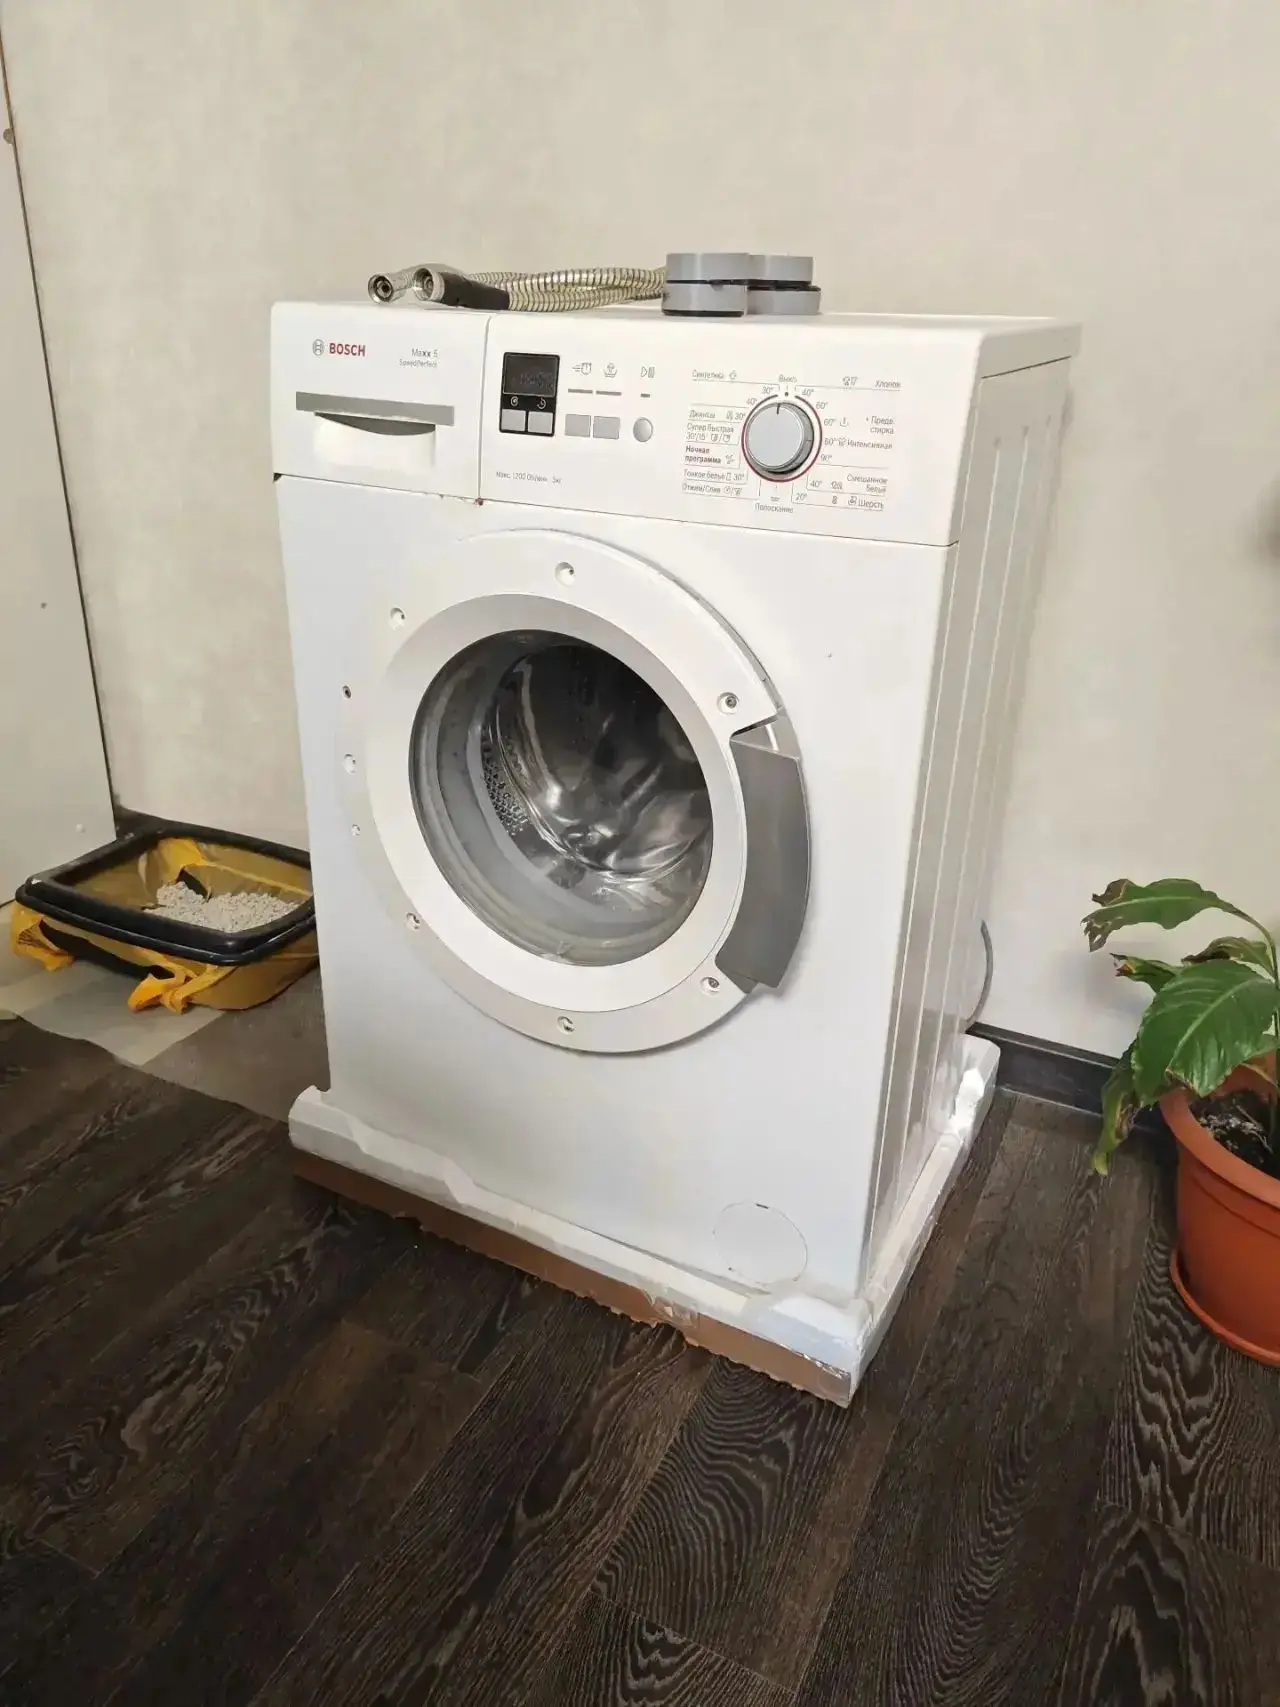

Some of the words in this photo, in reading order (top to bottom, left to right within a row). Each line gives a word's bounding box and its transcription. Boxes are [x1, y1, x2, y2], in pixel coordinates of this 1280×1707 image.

[328, 342, 366, 357] BOSCH
[411, 347, 431, 357] Maxx
[433, 349, 438, 357] 5
[399, 358, 437, 368] SpeedPerfect
[691, 370, 725, 380] Синтетика
[874, 379, 901, 389] Хлопок
[688, 409, 716, 419] Джинсы
[686, 422, 706, 433] Супер
[707, 424, 734, 434] быстрая
[869, 427, 894, 435] стирка
[847, 439, 892, 449] Интенсивная
[685, 445, 711, 454] Ночная
[684, 454, 722, 465] программа
[683, 469, 706, 480] Тонкое
[846, 473, 889, 485] Смешанное
[682, 484, 720, 493] Отжим/Слив
[754, 502, 794, 513] Полоскание
[858, 498, 885, 509] Шерсть
